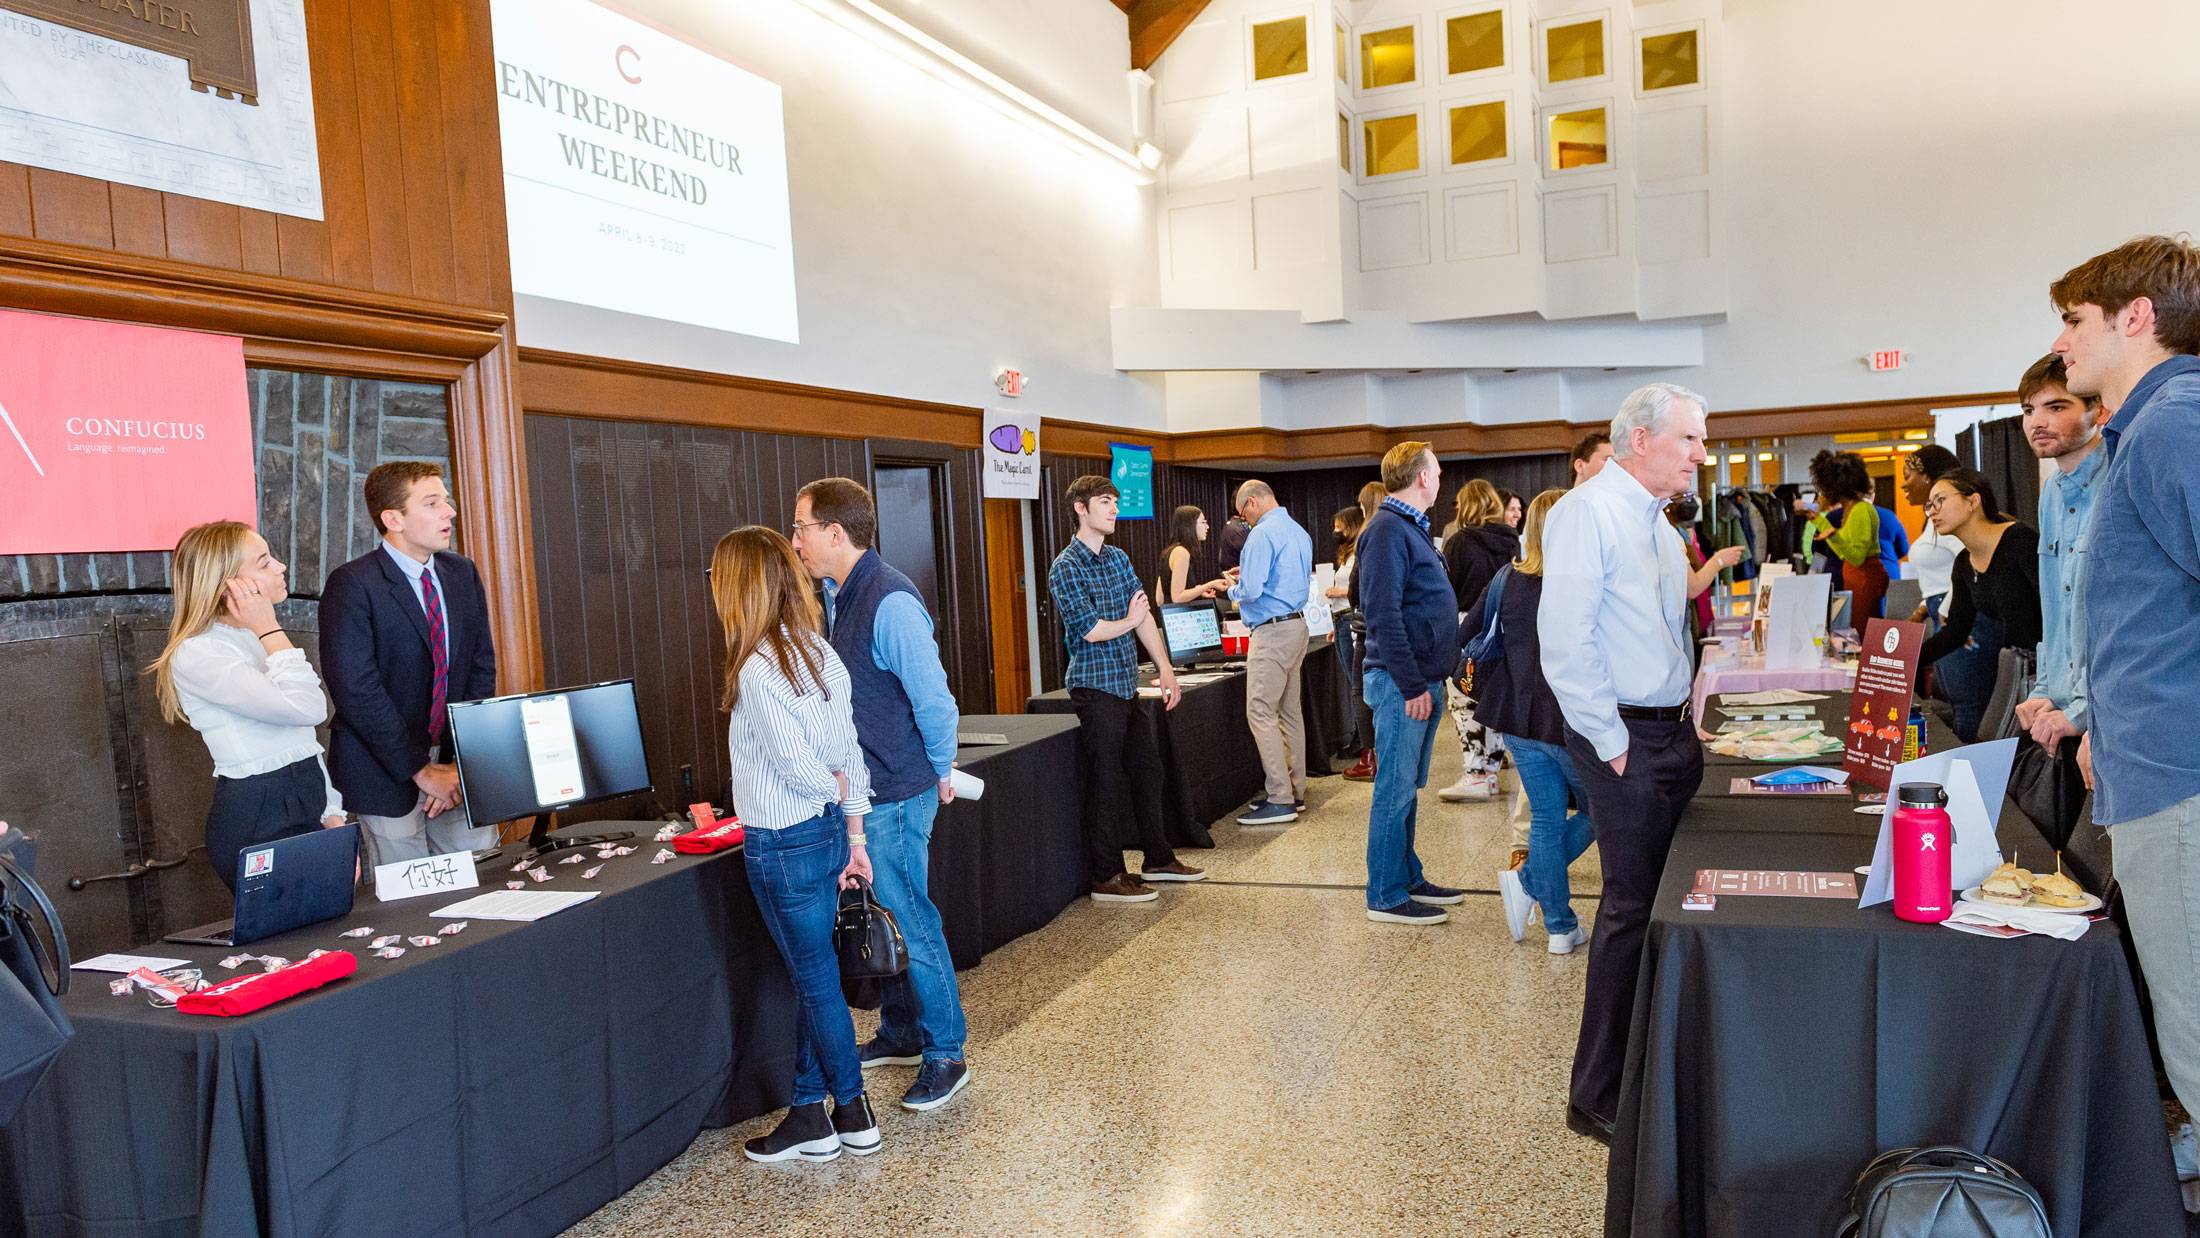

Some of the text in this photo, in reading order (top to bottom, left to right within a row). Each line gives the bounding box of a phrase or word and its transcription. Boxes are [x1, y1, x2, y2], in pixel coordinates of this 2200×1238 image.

[78, 0, 200, 38] ATER
[51, 26, 68, 45] BY
[74, 35, 103, 54] THE
[499, 60, 744, 176] ENTREPRENEUR
[557, 132, 708, 206] WEEKEND
[599, 222, 633, 242] APRIL
[1875, 351, 1900, 369] EXIT
[66, 417, 206, 440] CONFUCIUS
[401, 858, 459, 890] 你好
